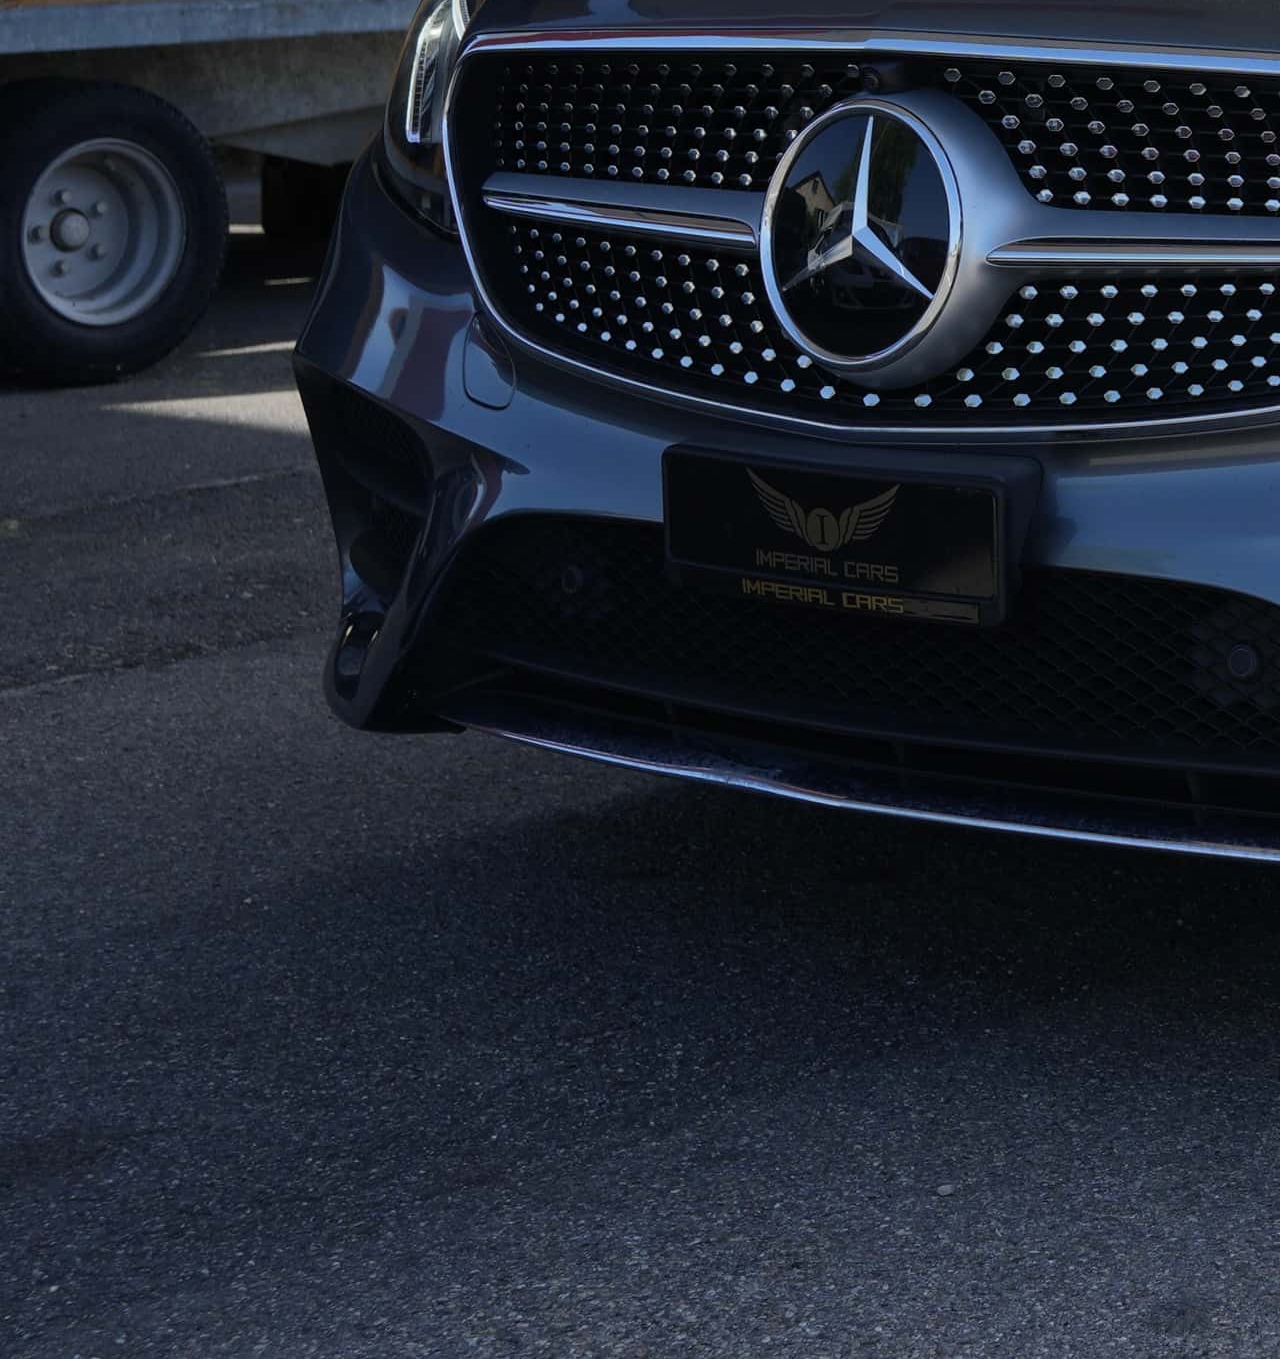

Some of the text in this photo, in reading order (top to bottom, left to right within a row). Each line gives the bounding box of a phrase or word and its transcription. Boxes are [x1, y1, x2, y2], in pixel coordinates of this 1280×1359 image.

[755, 547, 899, 584] IMPERIAL CARS
[742, 577, 905, 615] IMPERIAL CARS
